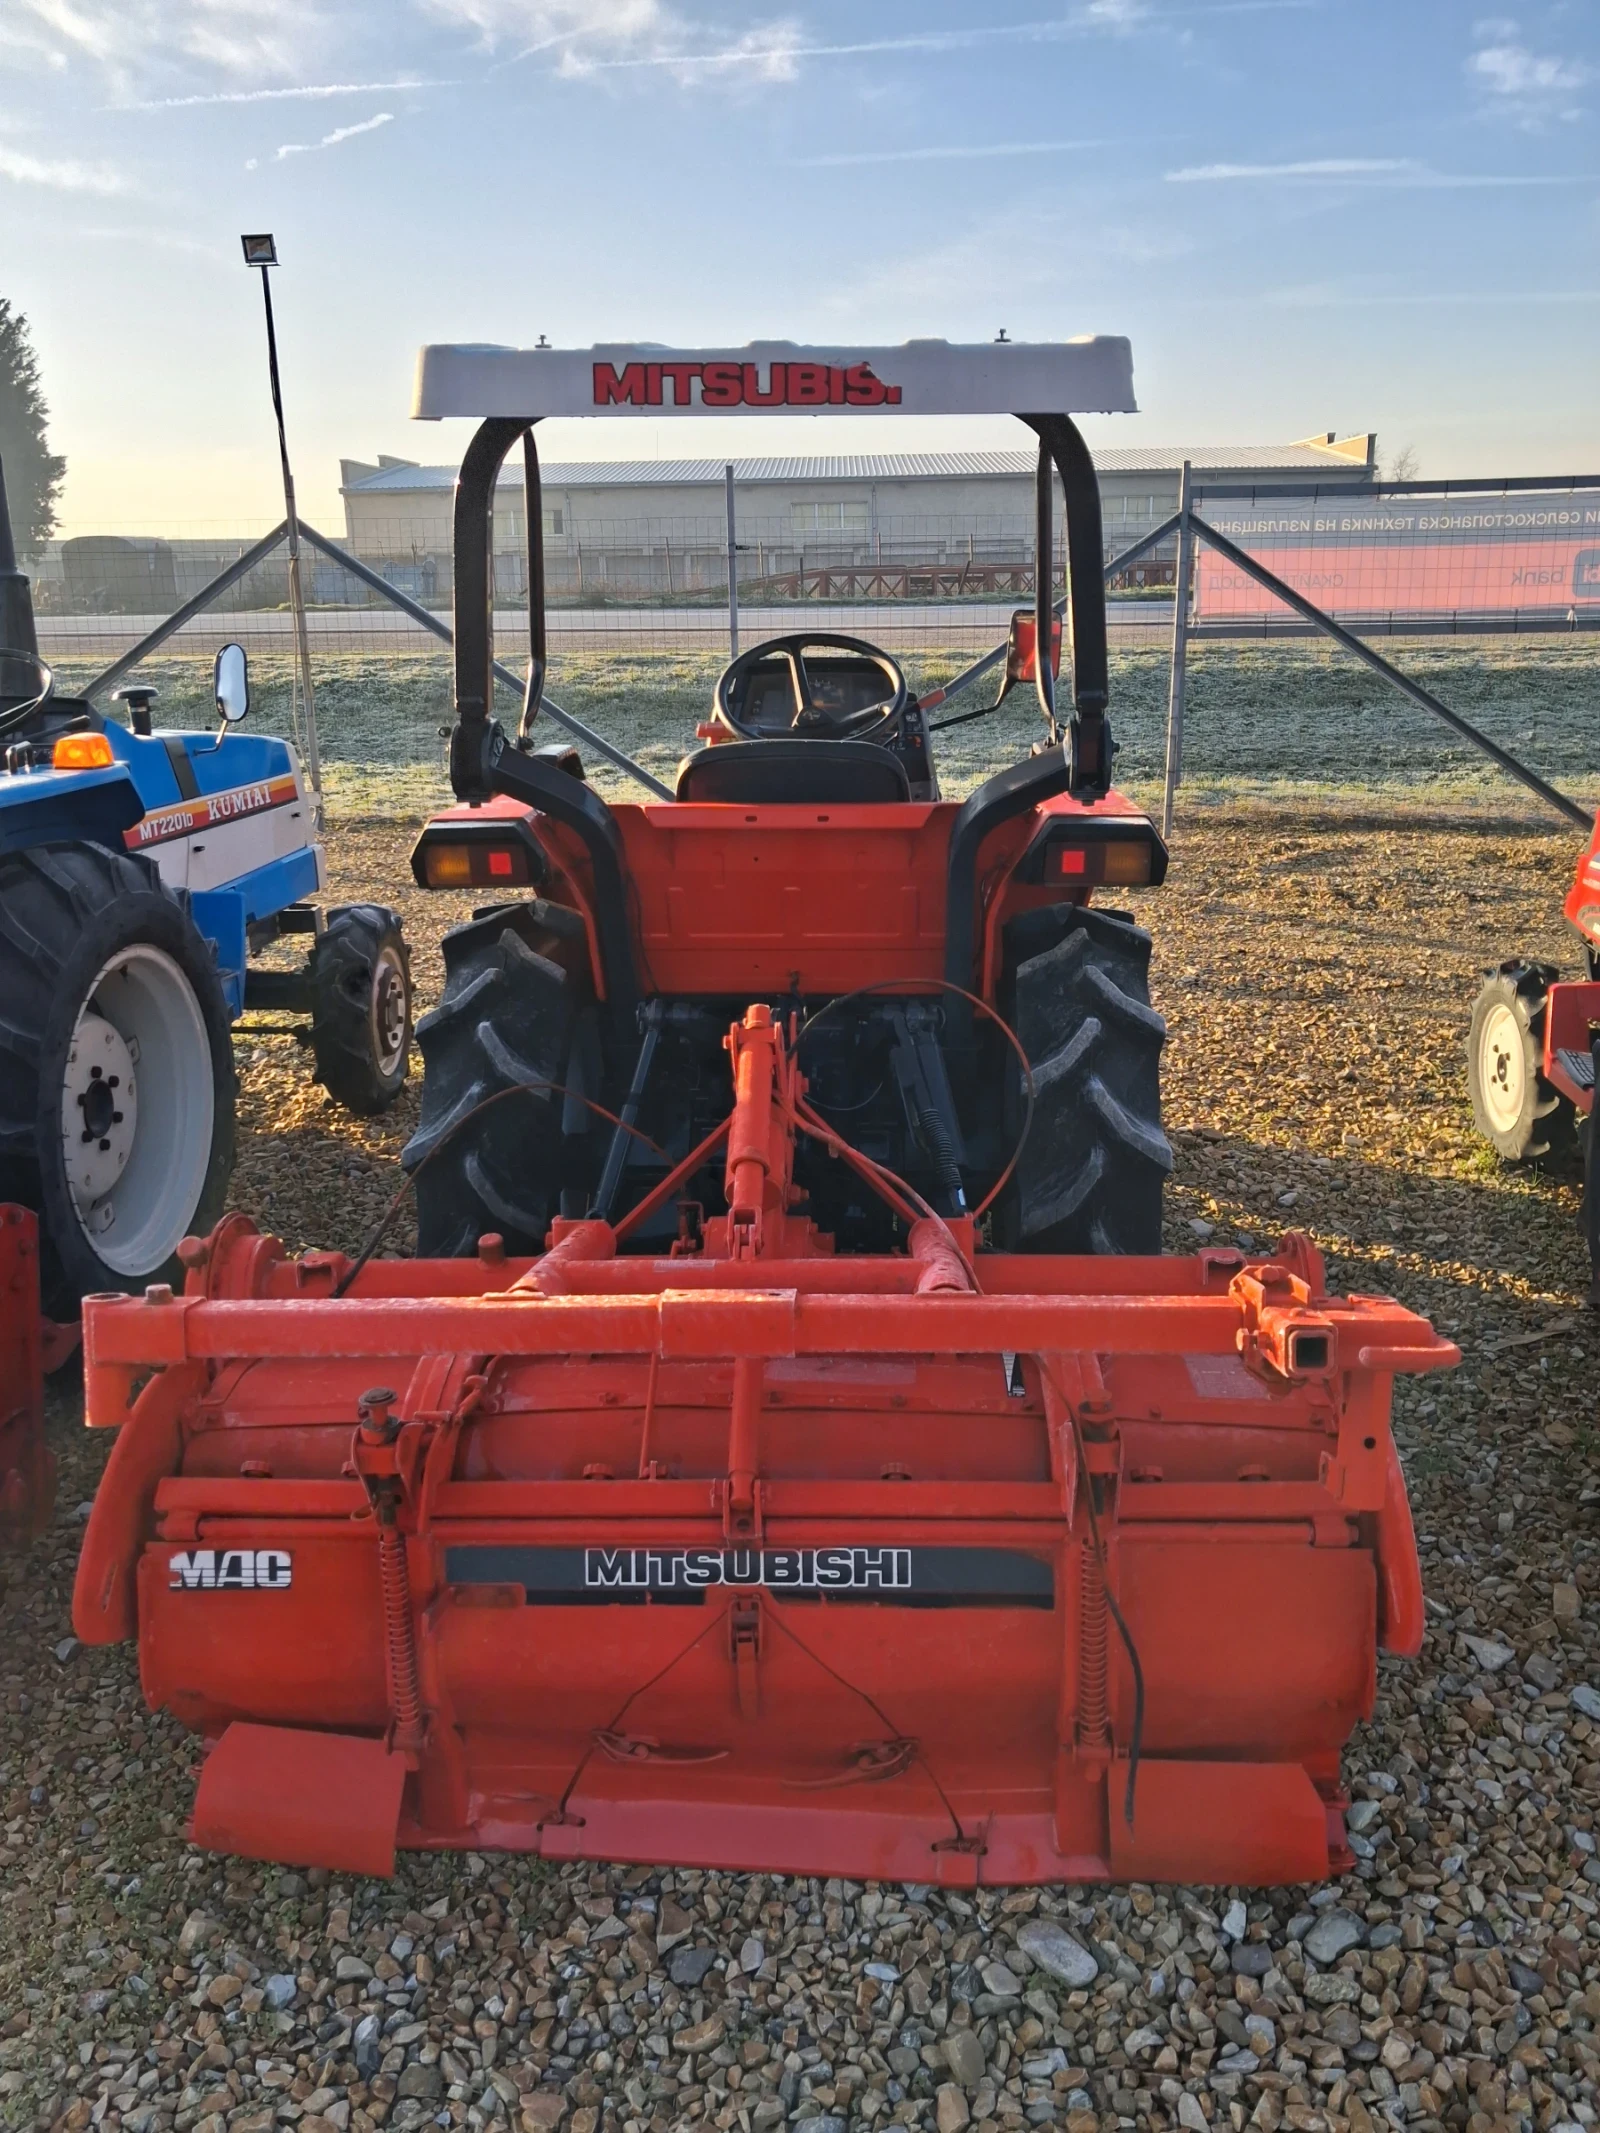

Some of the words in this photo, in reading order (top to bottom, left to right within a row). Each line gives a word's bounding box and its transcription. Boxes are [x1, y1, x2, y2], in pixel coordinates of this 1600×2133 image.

[139, 812, 194, 841] MT2201D
[207, 785, 272, 821] KUMIAI
[169, 1549, 292, 1588] MAC
[584, 1546, 912, 1588] MITSUBISHI
